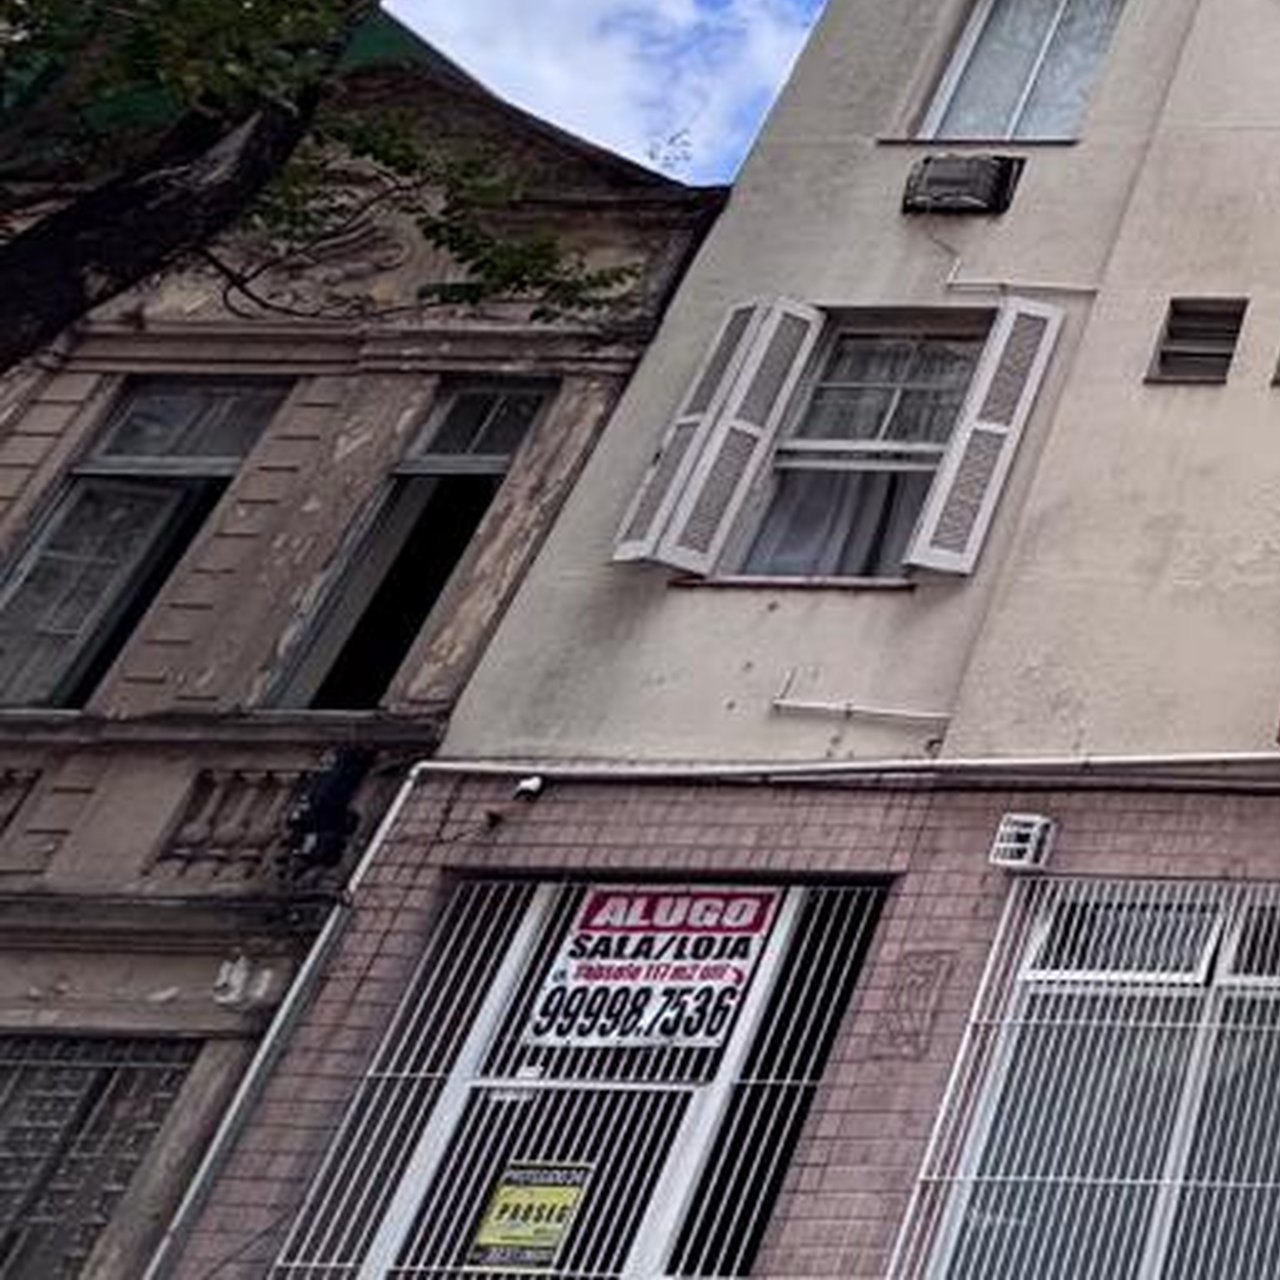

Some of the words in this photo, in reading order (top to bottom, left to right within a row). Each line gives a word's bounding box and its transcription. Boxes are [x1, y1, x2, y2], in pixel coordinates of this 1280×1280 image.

[589, 895, 762, 928] ALUGO
[568, 933, 751, 960] SALA/LOJA
[532, 985, 740, 1037] 99998.7536
